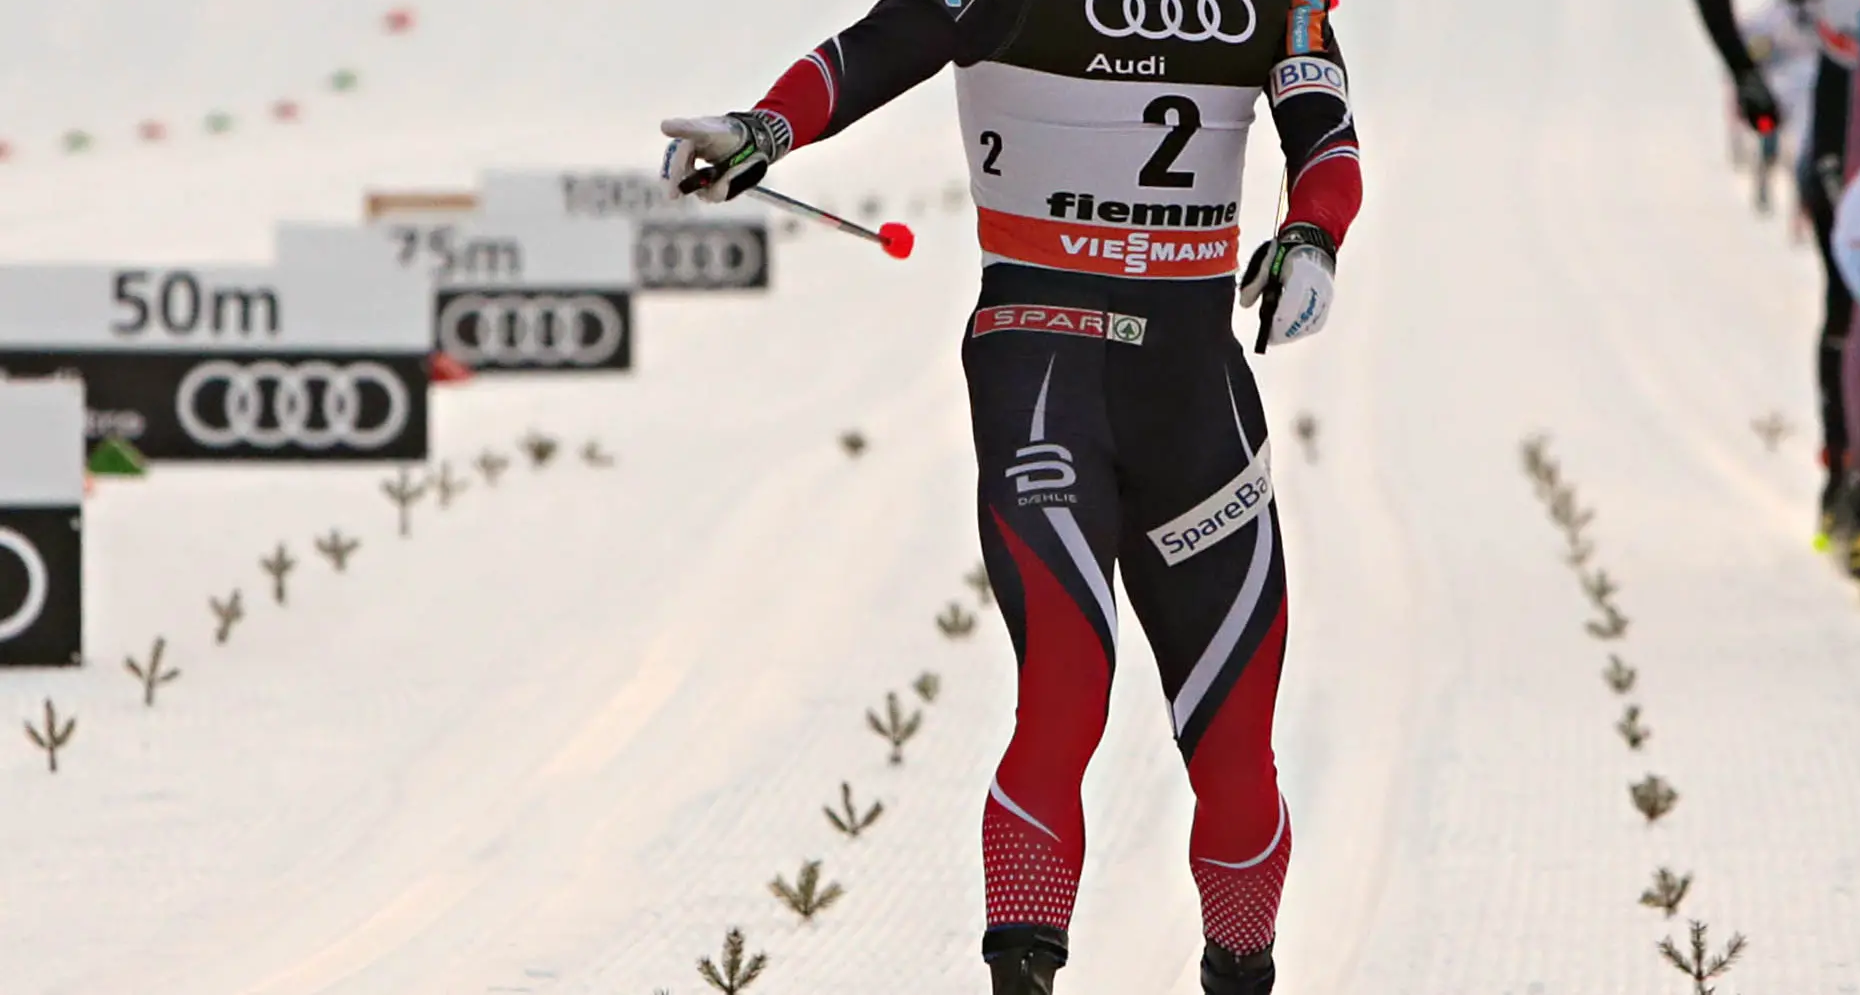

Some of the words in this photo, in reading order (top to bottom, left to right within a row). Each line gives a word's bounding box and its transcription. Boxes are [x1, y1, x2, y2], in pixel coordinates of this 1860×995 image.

[1086, 54, 1166, 75] Audi
[1280, 62, 1342, 87] BDO
[980, 131, 1003, 176] 2
[1139, 95, 1201, 188] 2
[1046, 192, 1237, 227] fiemme
[1060, 232, 1228, 274] VIESSMANN
[109, 269, 279, 336] 50m
[993, 310, 1105, 334] SPAR
[1161, 475, 1269, 555] SpareBa
